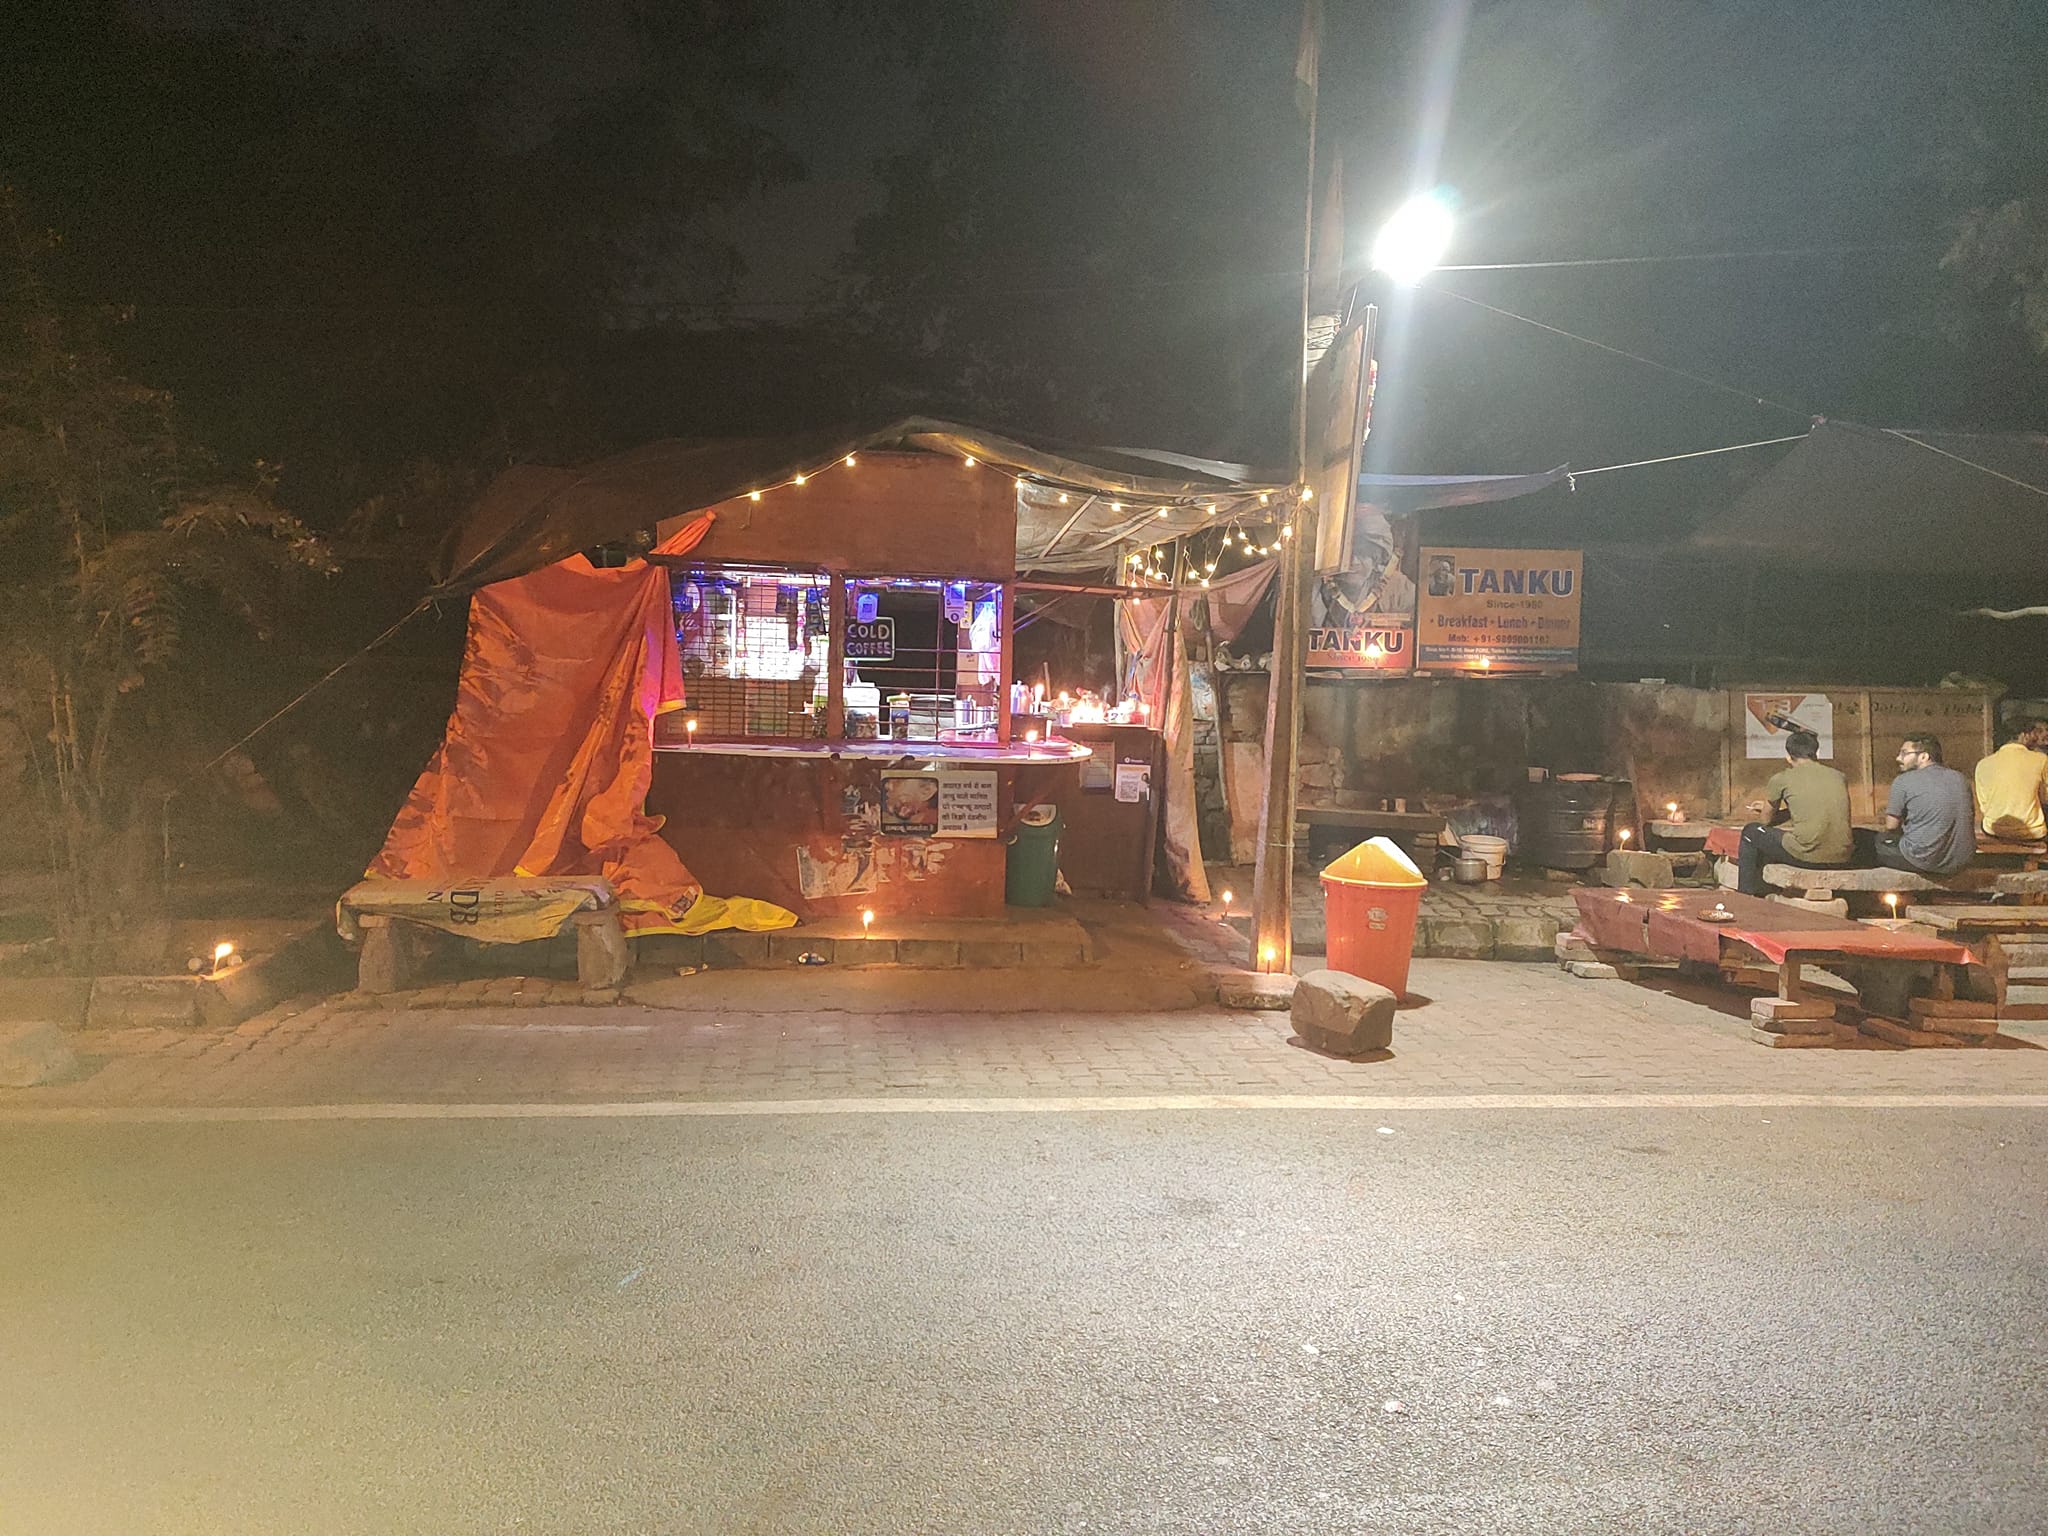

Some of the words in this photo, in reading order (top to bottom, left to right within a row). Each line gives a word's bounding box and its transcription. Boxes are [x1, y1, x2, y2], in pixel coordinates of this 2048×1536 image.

[1458, 567, 1575, 597] TANKU
[1438, 614, 1488, 629] Breakfast
[1497, 616, 1528, 629] Lunch
[847, 624, 890, 639] COLD
[846, 642, 891, 655] COFFEE
[1308, 628, 1405, 654] TANKU
